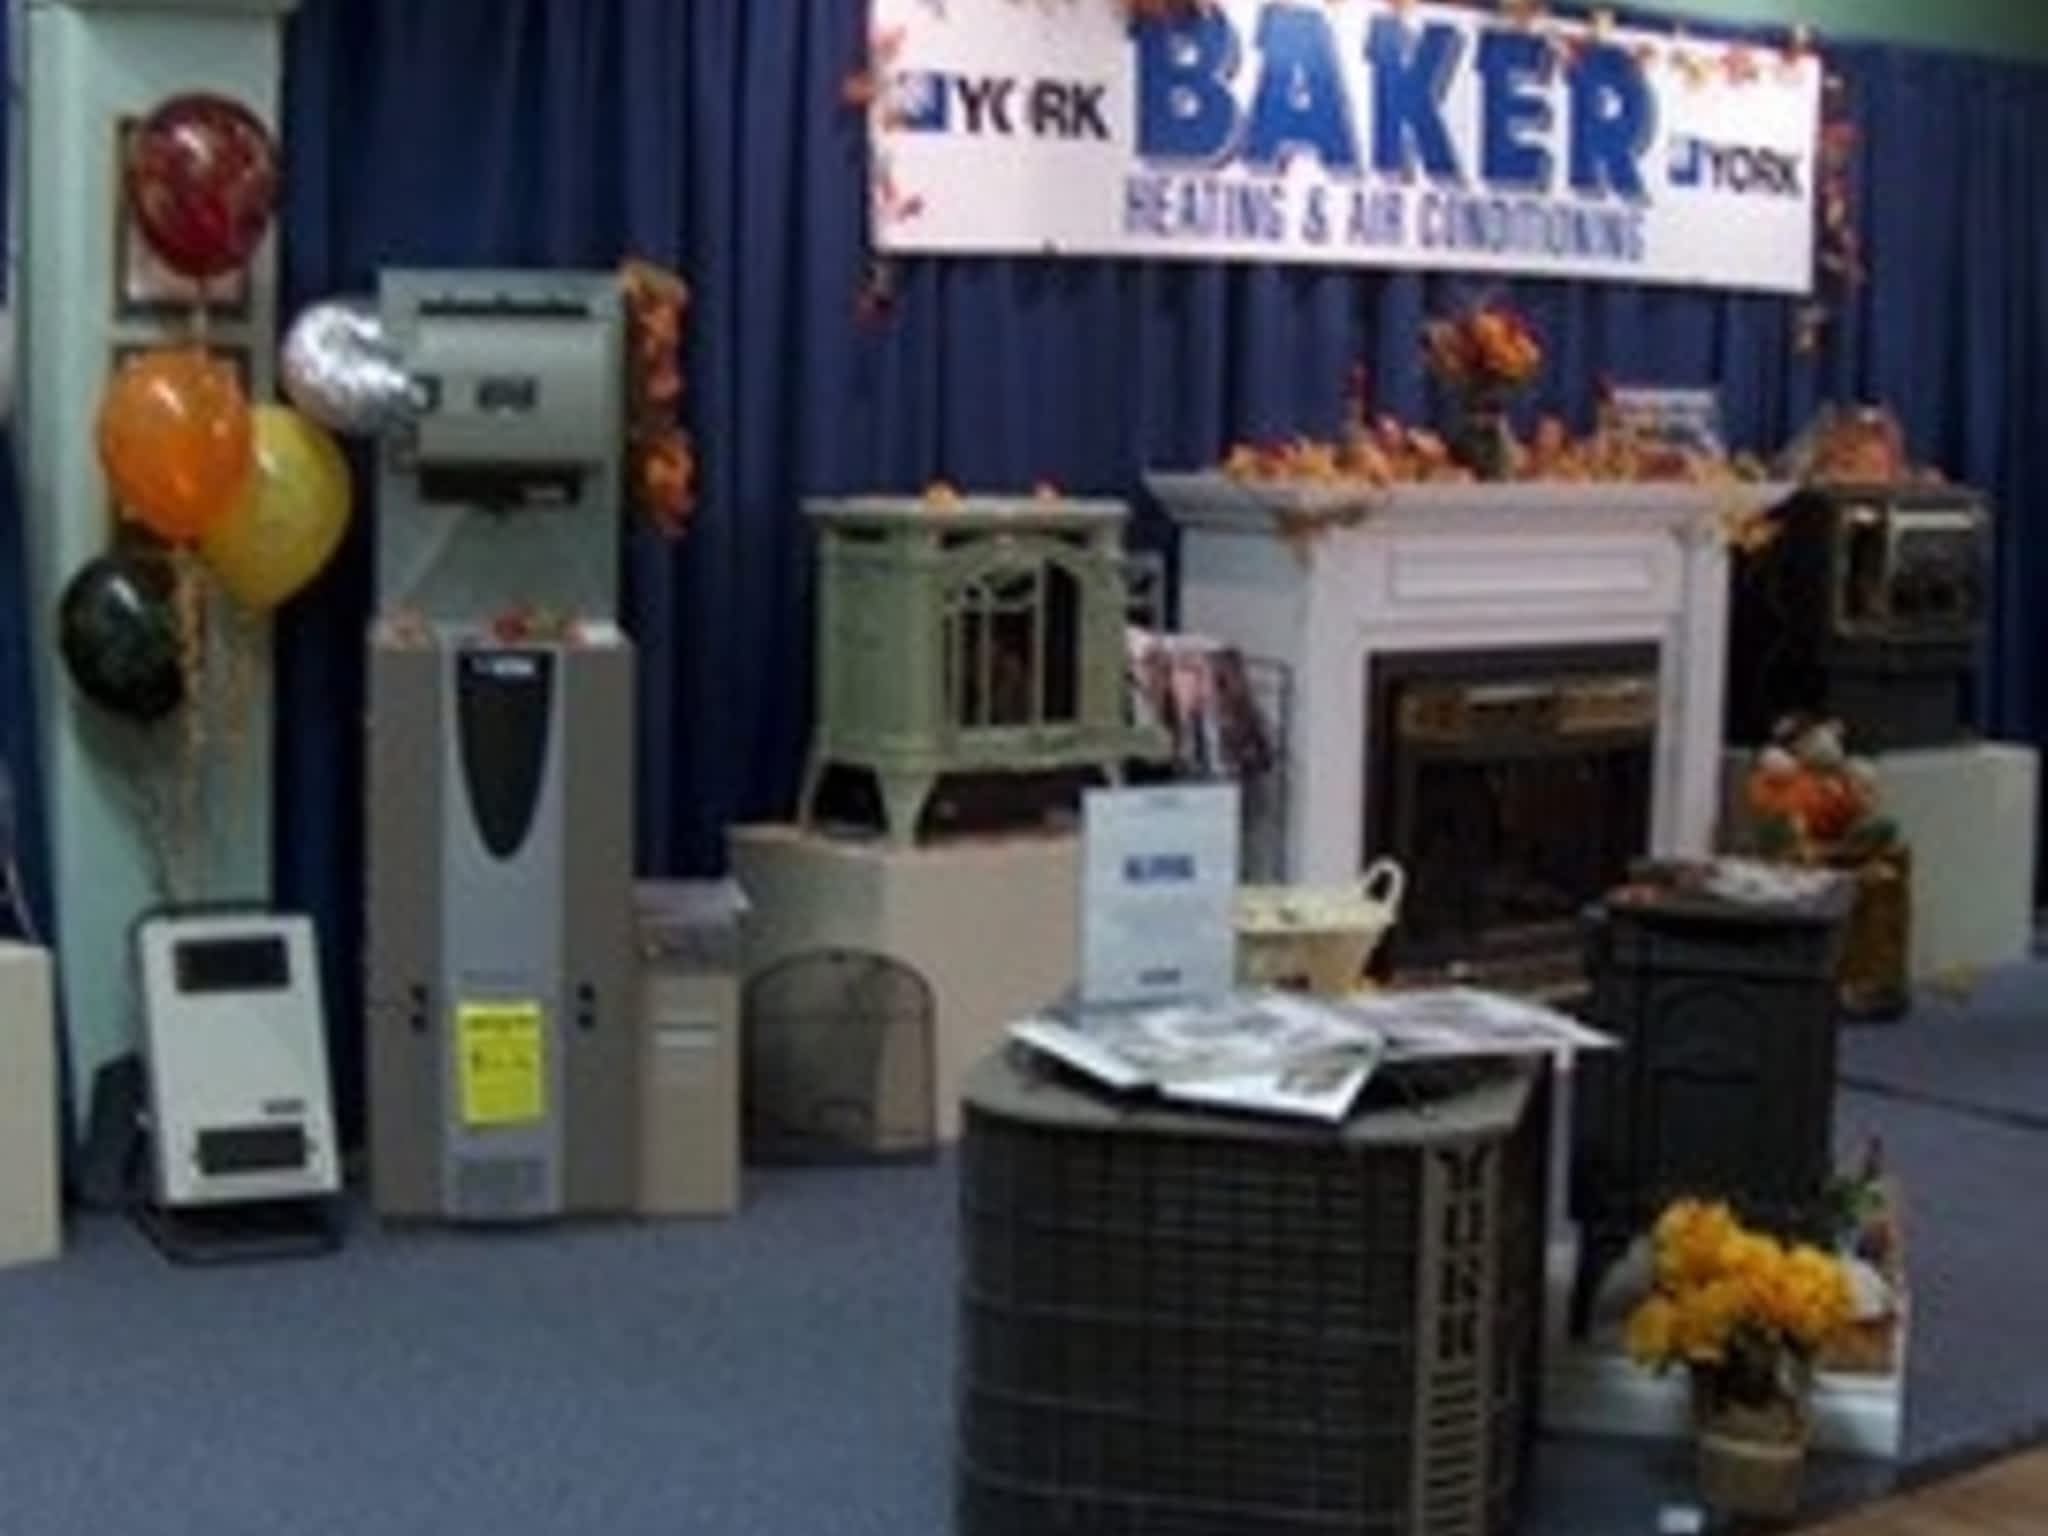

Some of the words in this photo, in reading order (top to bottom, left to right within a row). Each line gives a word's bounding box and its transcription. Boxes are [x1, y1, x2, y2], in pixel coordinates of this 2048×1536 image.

[1126, 0, 1657, 208] BAKER
[1703, 144, 1804, 201] YORK
[1124, 174, 1286, 241] HEATING
[1345, 189, 1401, 249] AIR
[1415, 190, 1645, 263] CONDITIONING
